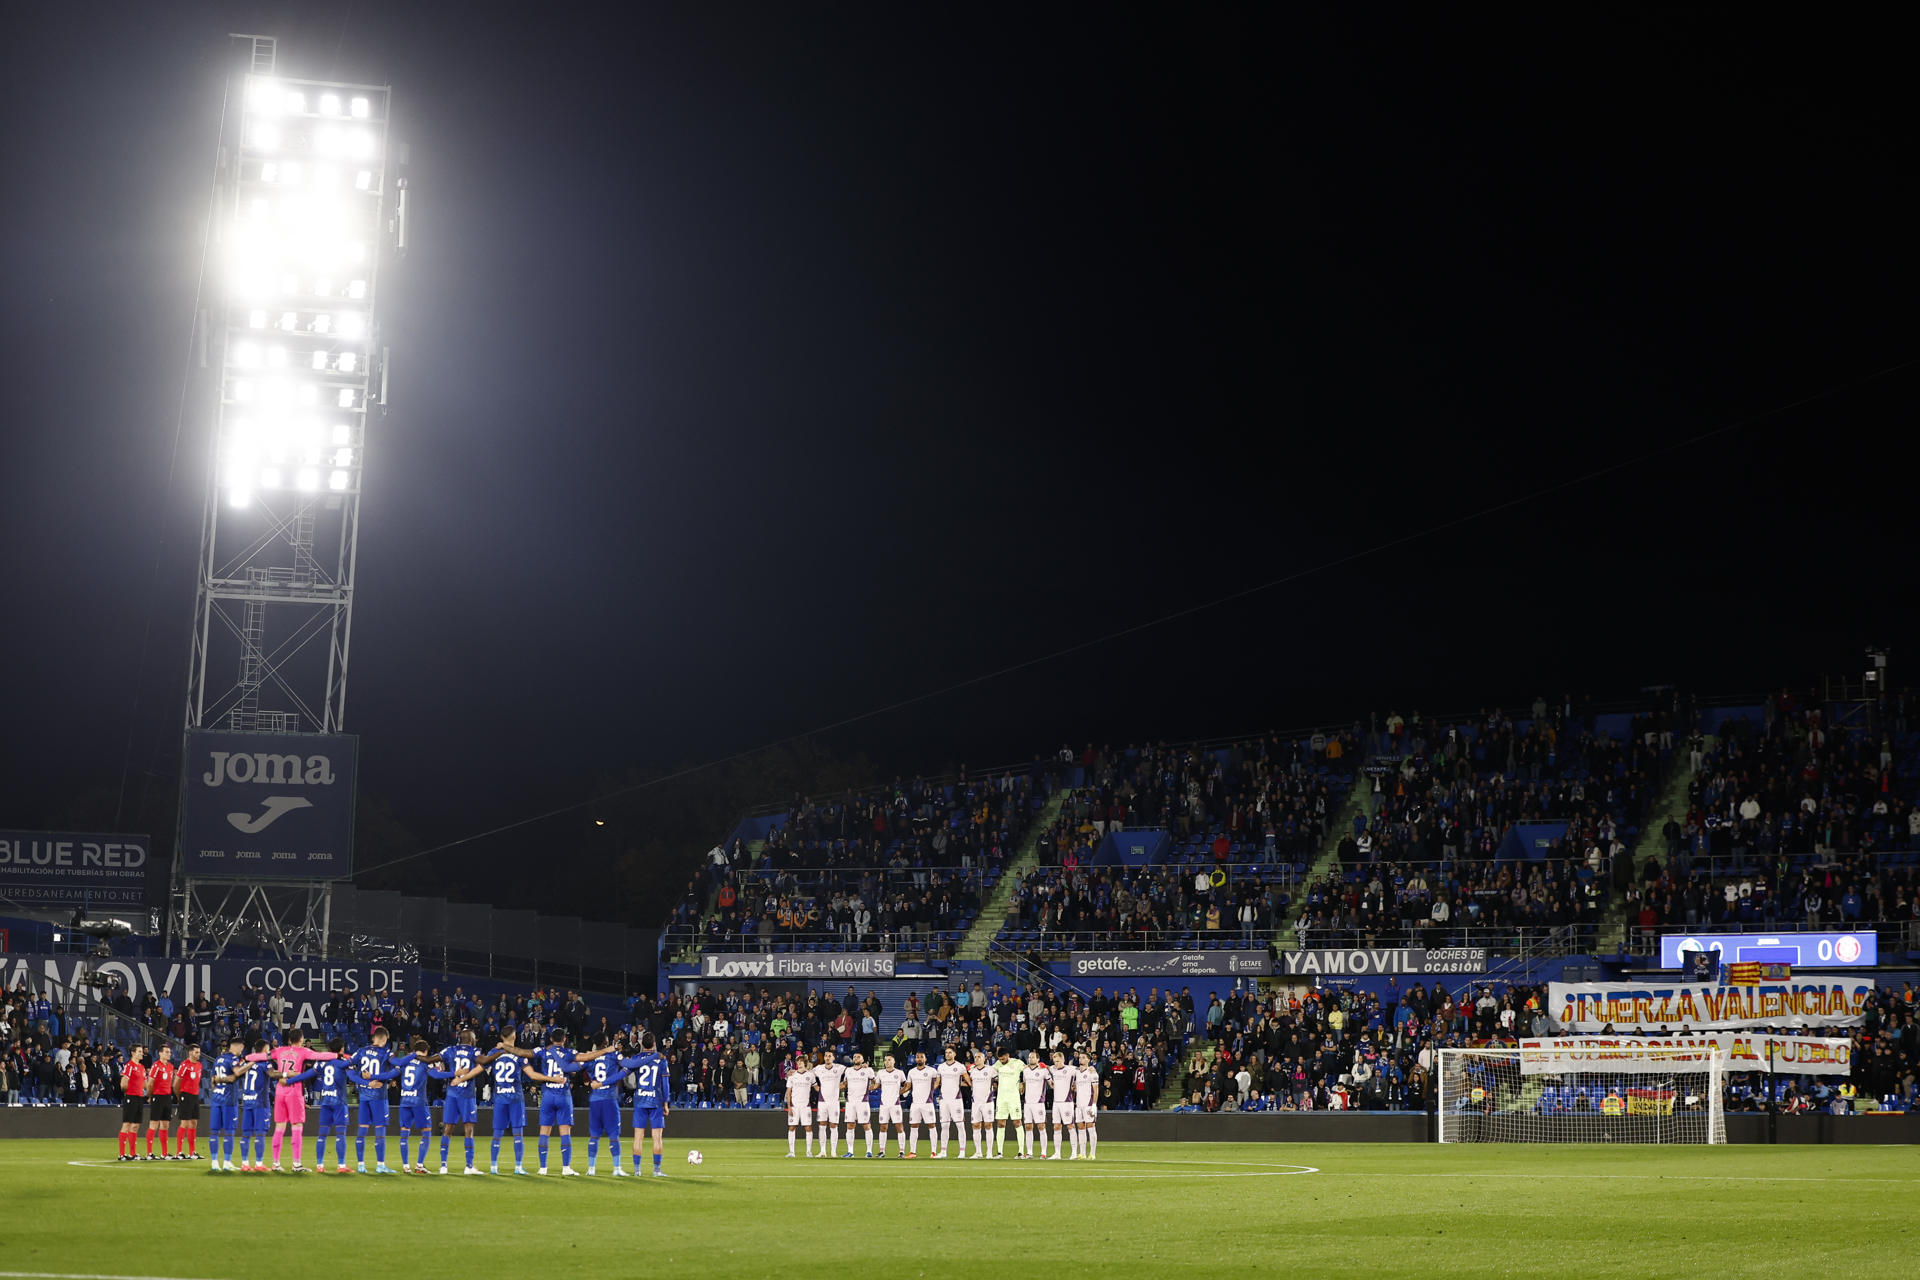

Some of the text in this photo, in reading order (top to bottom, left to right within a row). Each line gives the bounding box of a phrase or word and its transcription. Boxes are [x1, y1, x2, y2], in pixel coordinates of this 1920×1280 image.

[203, 752, 335, 787] Joma
[82, 843, 145, 868] RED
[67, 868, 104, 877] TUBERÍAS
[1426, 950, 1485, 960] COCHES DE
[1818, 940, 1832, 961] 0
[706, 954, 893, 976] Lowi Fibra + Móvil 5G
[1285, 951, 1418, 974] YAMOVIL
[1424, 961, 1481, 973] OCASIÓN
[245, 967, 405, 993] COCHES DE
[1560, 988, 1701, 1023] ¡FUERZA
[1523, 1042, 1549, 1062] EL
[1554, 1039, 1644, 1062] PUEBLO
[1731, 1038, 1758, 1060] AL
[1765, 1039, 1850, 1064] PUEBLO
[324, 1065, 334, 1086] 8
[361, 1057, 380, 1076] 20
[404, 1065, 416, 1086] 5
[495, 1061, 515, 1083] 22
[547, 1059, 563, 1077] 15
[594, 1062, 607, 1082] 6
[639, 1065, 659, 1087] 21
[244, 1068, 258, 1091] 17
[497, 1086, 516, 1094] Lowi
[638, 1088, 656, 1097] Lowi
